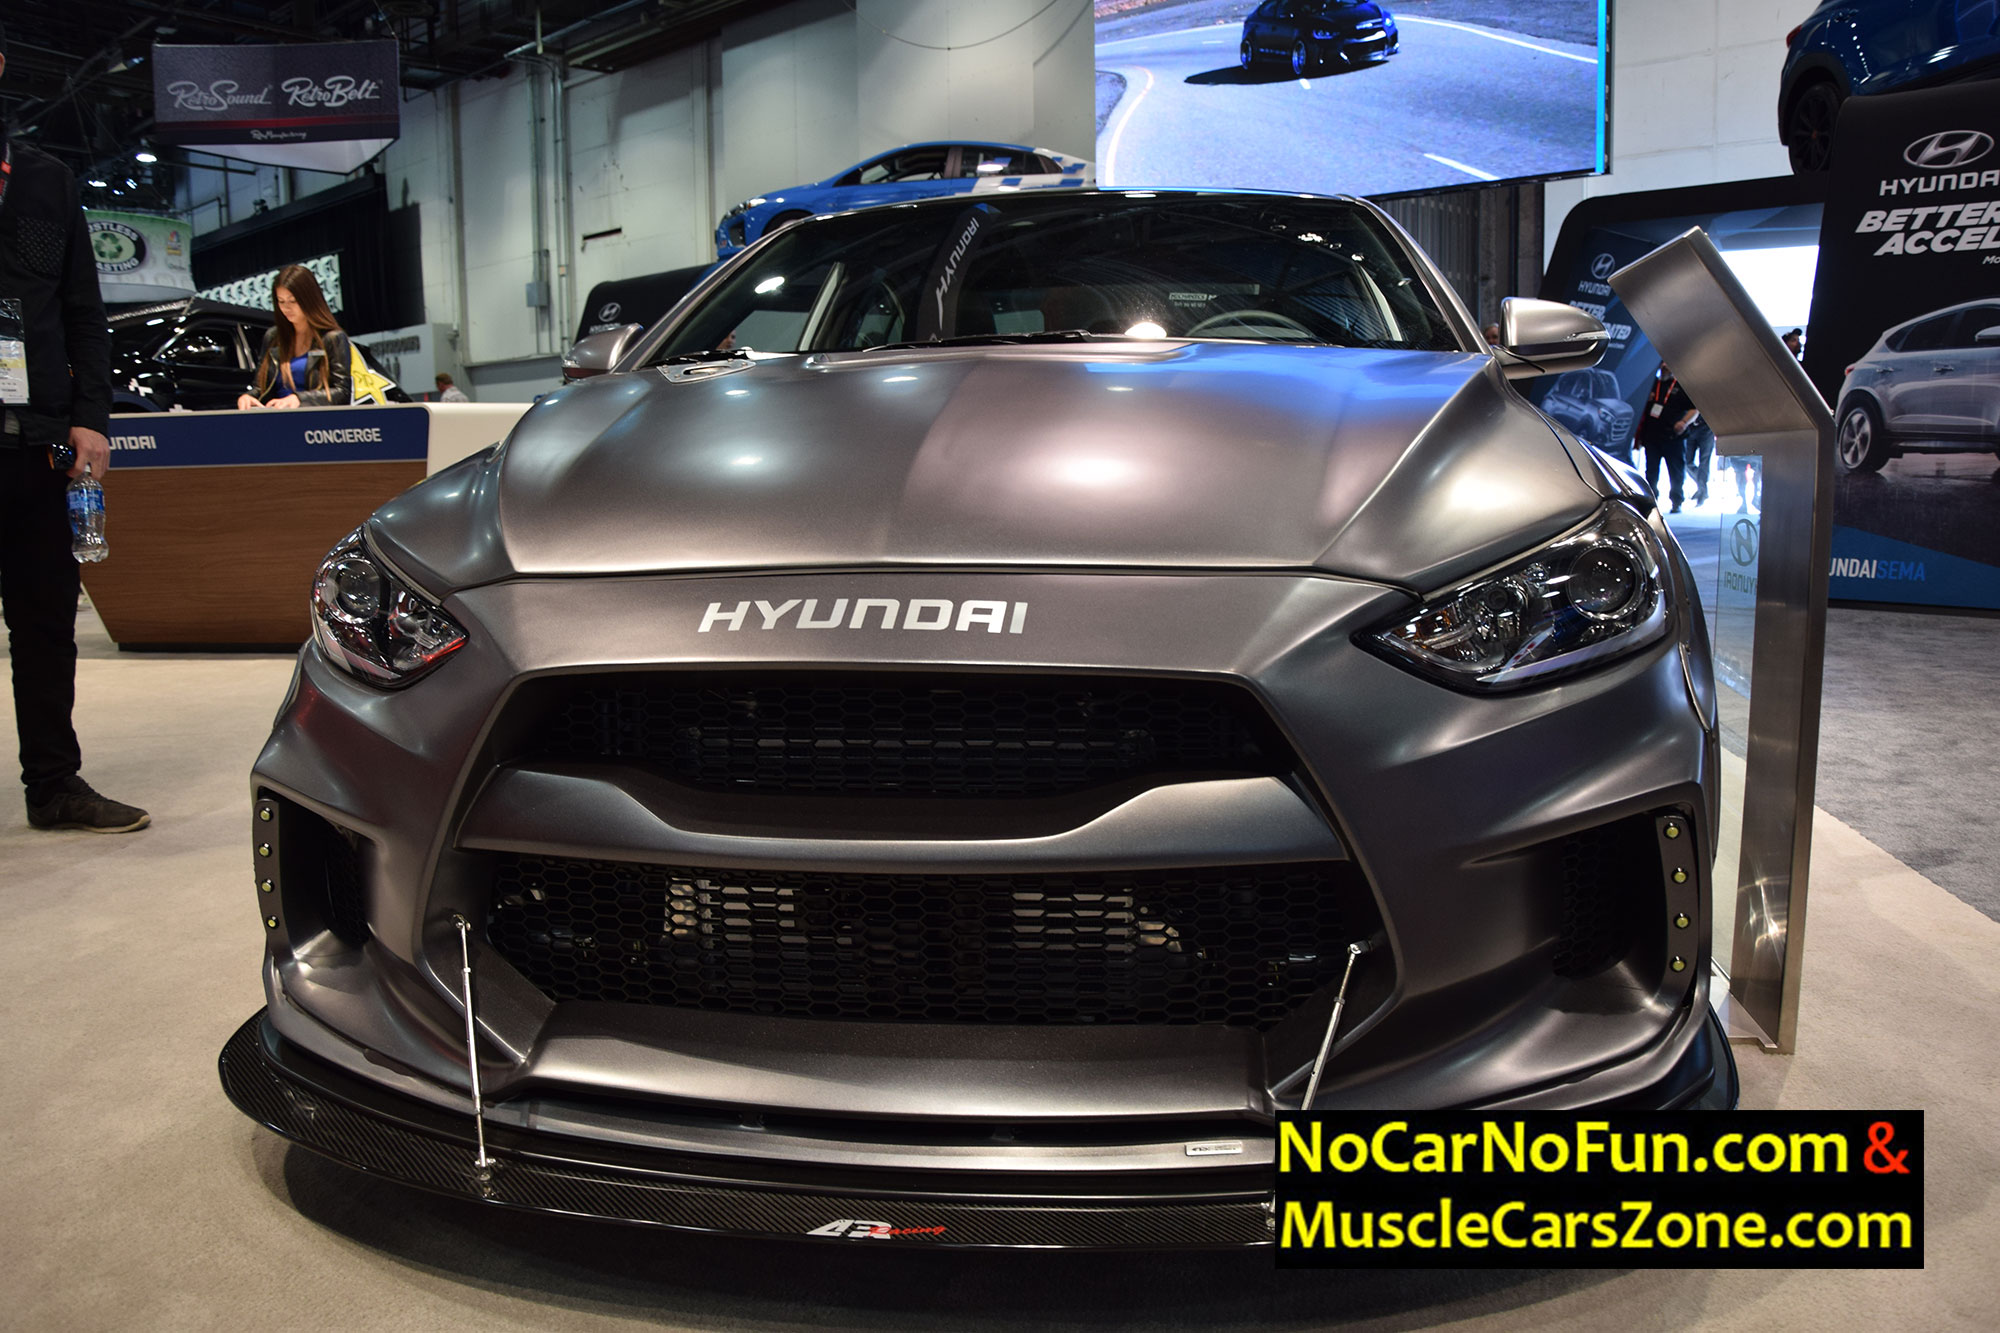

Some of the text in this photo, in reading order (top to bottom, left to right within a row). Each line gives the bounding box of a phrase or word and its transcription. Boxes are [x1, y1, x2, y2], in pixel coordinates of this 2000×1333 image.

[166, 75, 381, 112] RetroSound RetroBelt
[1879, 169, 2000, 196] HYUNDA
[1855, 200, 2000, 233] BETTER
[1873, 226, 2000, 256] ACCEL
[304, 428, 382, 444] CONCIERGE
[697, 598, 1028, 634] HYUNDAI
